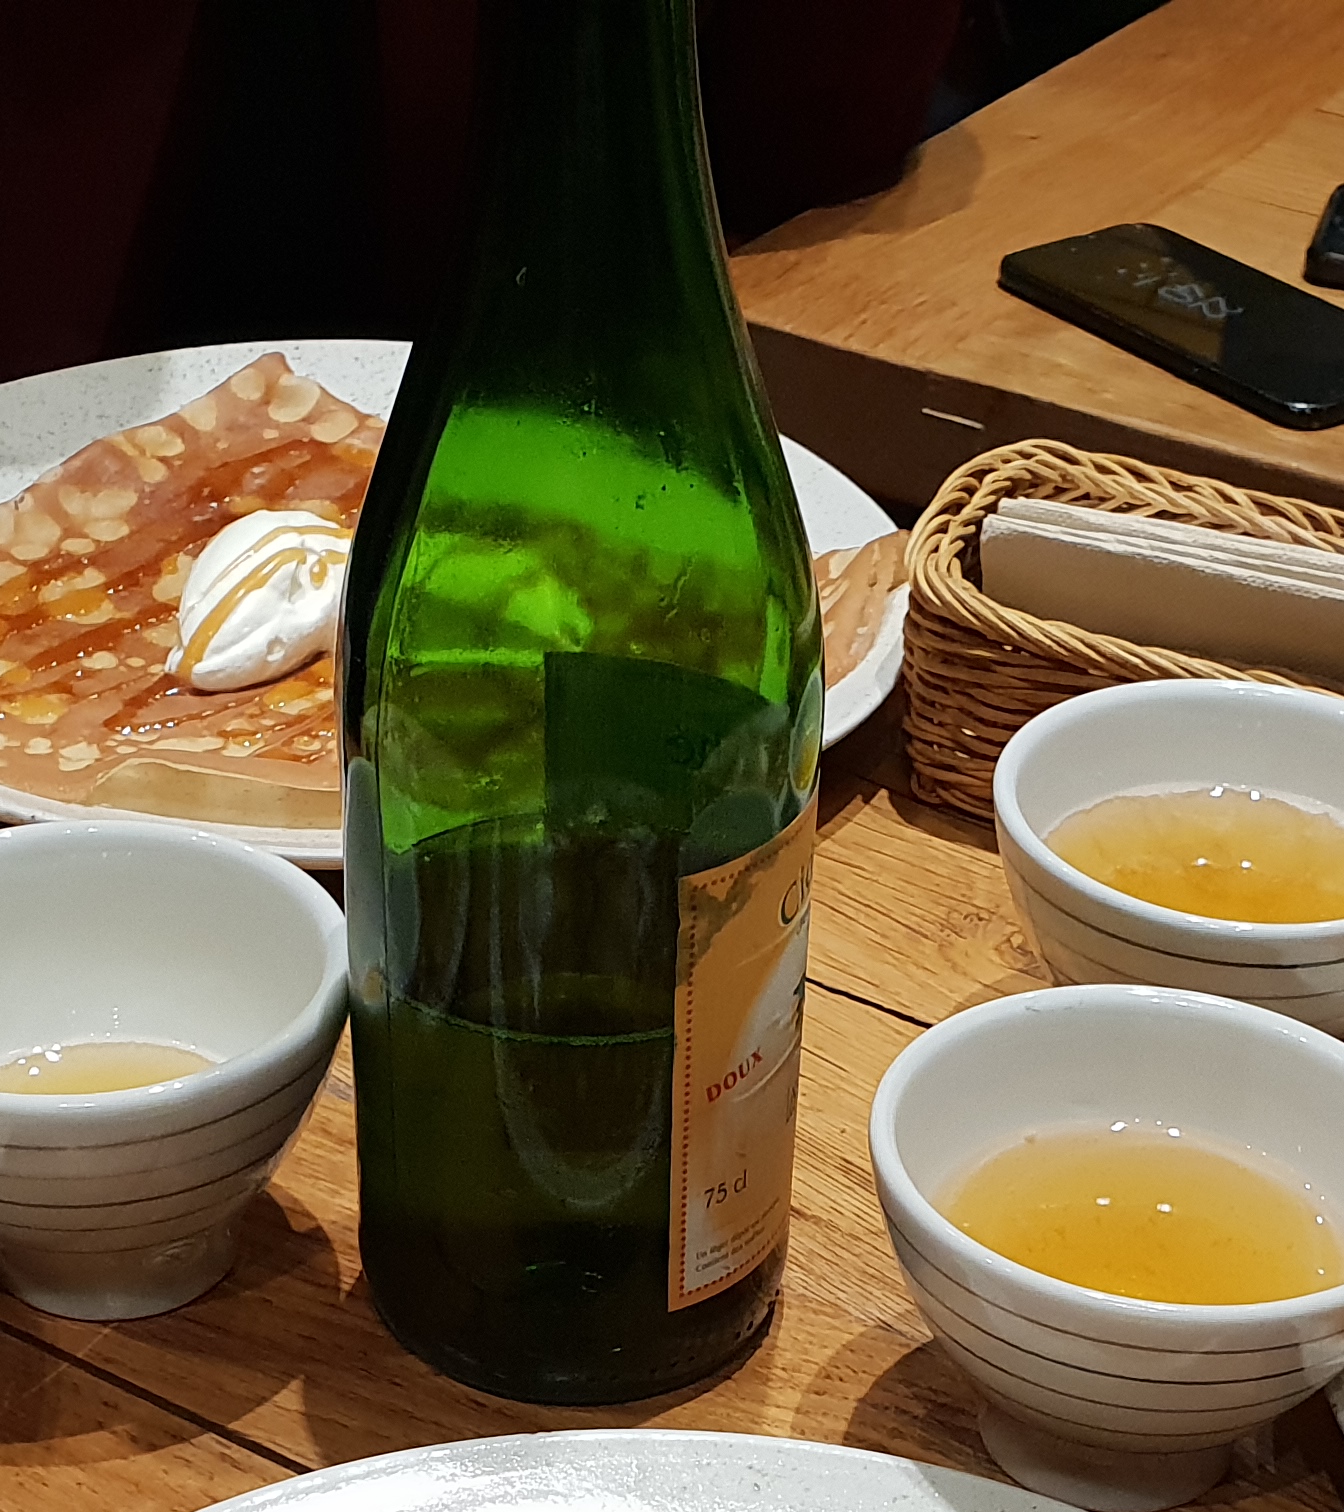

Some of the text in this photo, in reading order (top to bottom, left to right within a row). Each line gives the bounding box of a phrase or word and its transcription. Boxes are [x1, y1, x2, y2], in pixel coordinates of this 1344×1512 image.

[705, 1047, 763, 1103] DOUX
[703, 1168, 747, 1209] 75 cl
